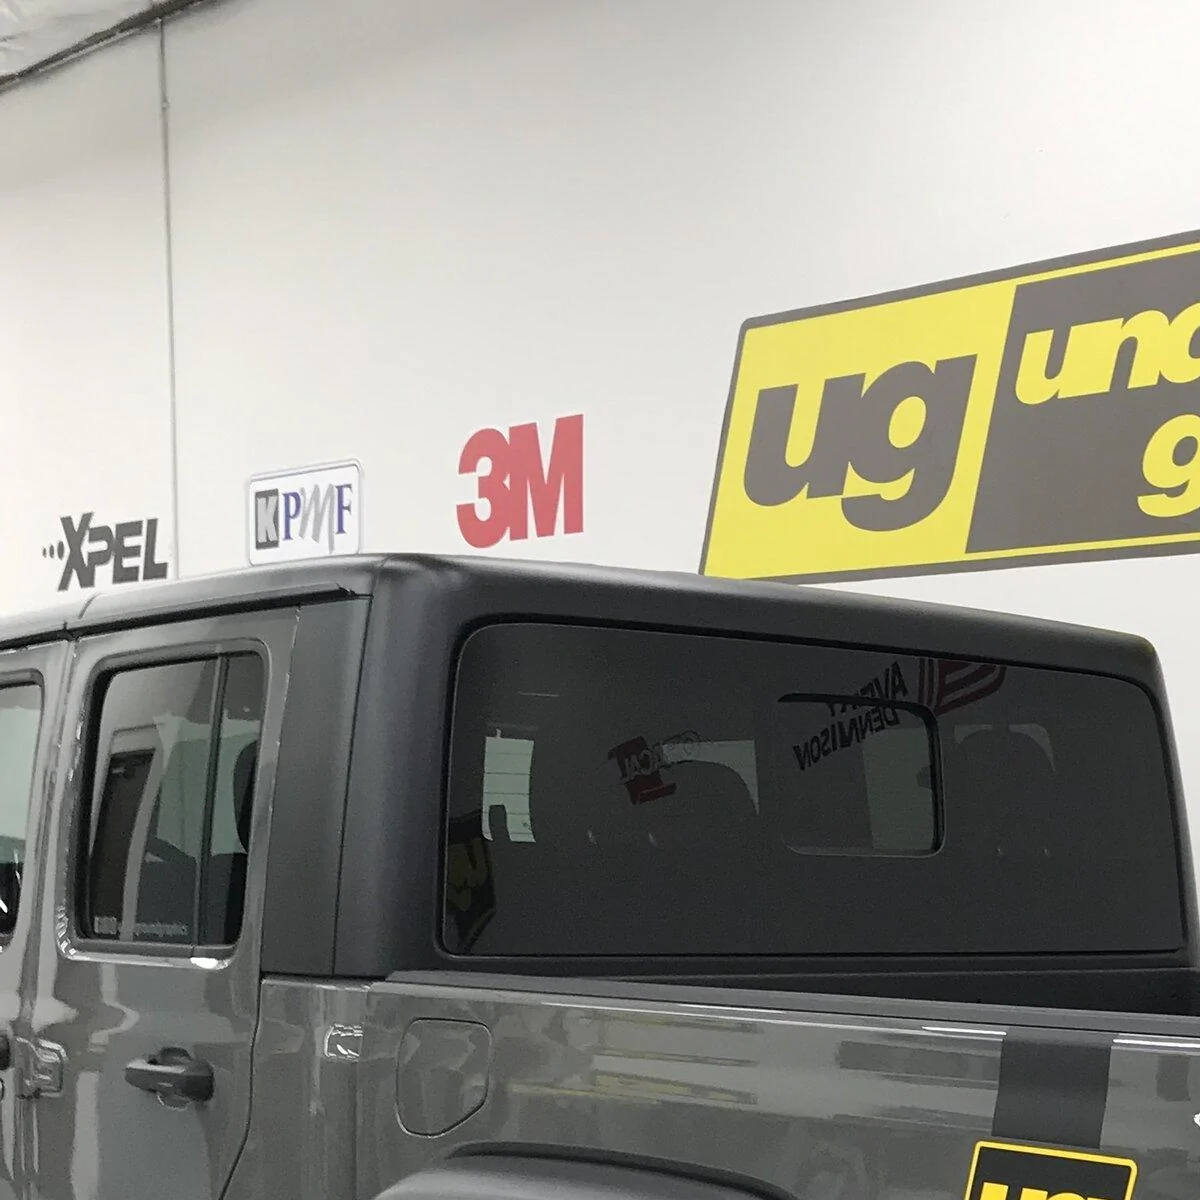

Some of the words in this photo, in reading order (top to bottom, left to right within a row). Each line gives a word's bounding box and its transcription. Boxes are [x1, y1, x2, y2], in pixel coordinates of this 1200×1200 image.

[457, 416, 584, 549] 3M
[745, 357, 977, 531] ug
[57, 512, 168, 592] XPEL
[254, 482, 354, 554] KPMF
